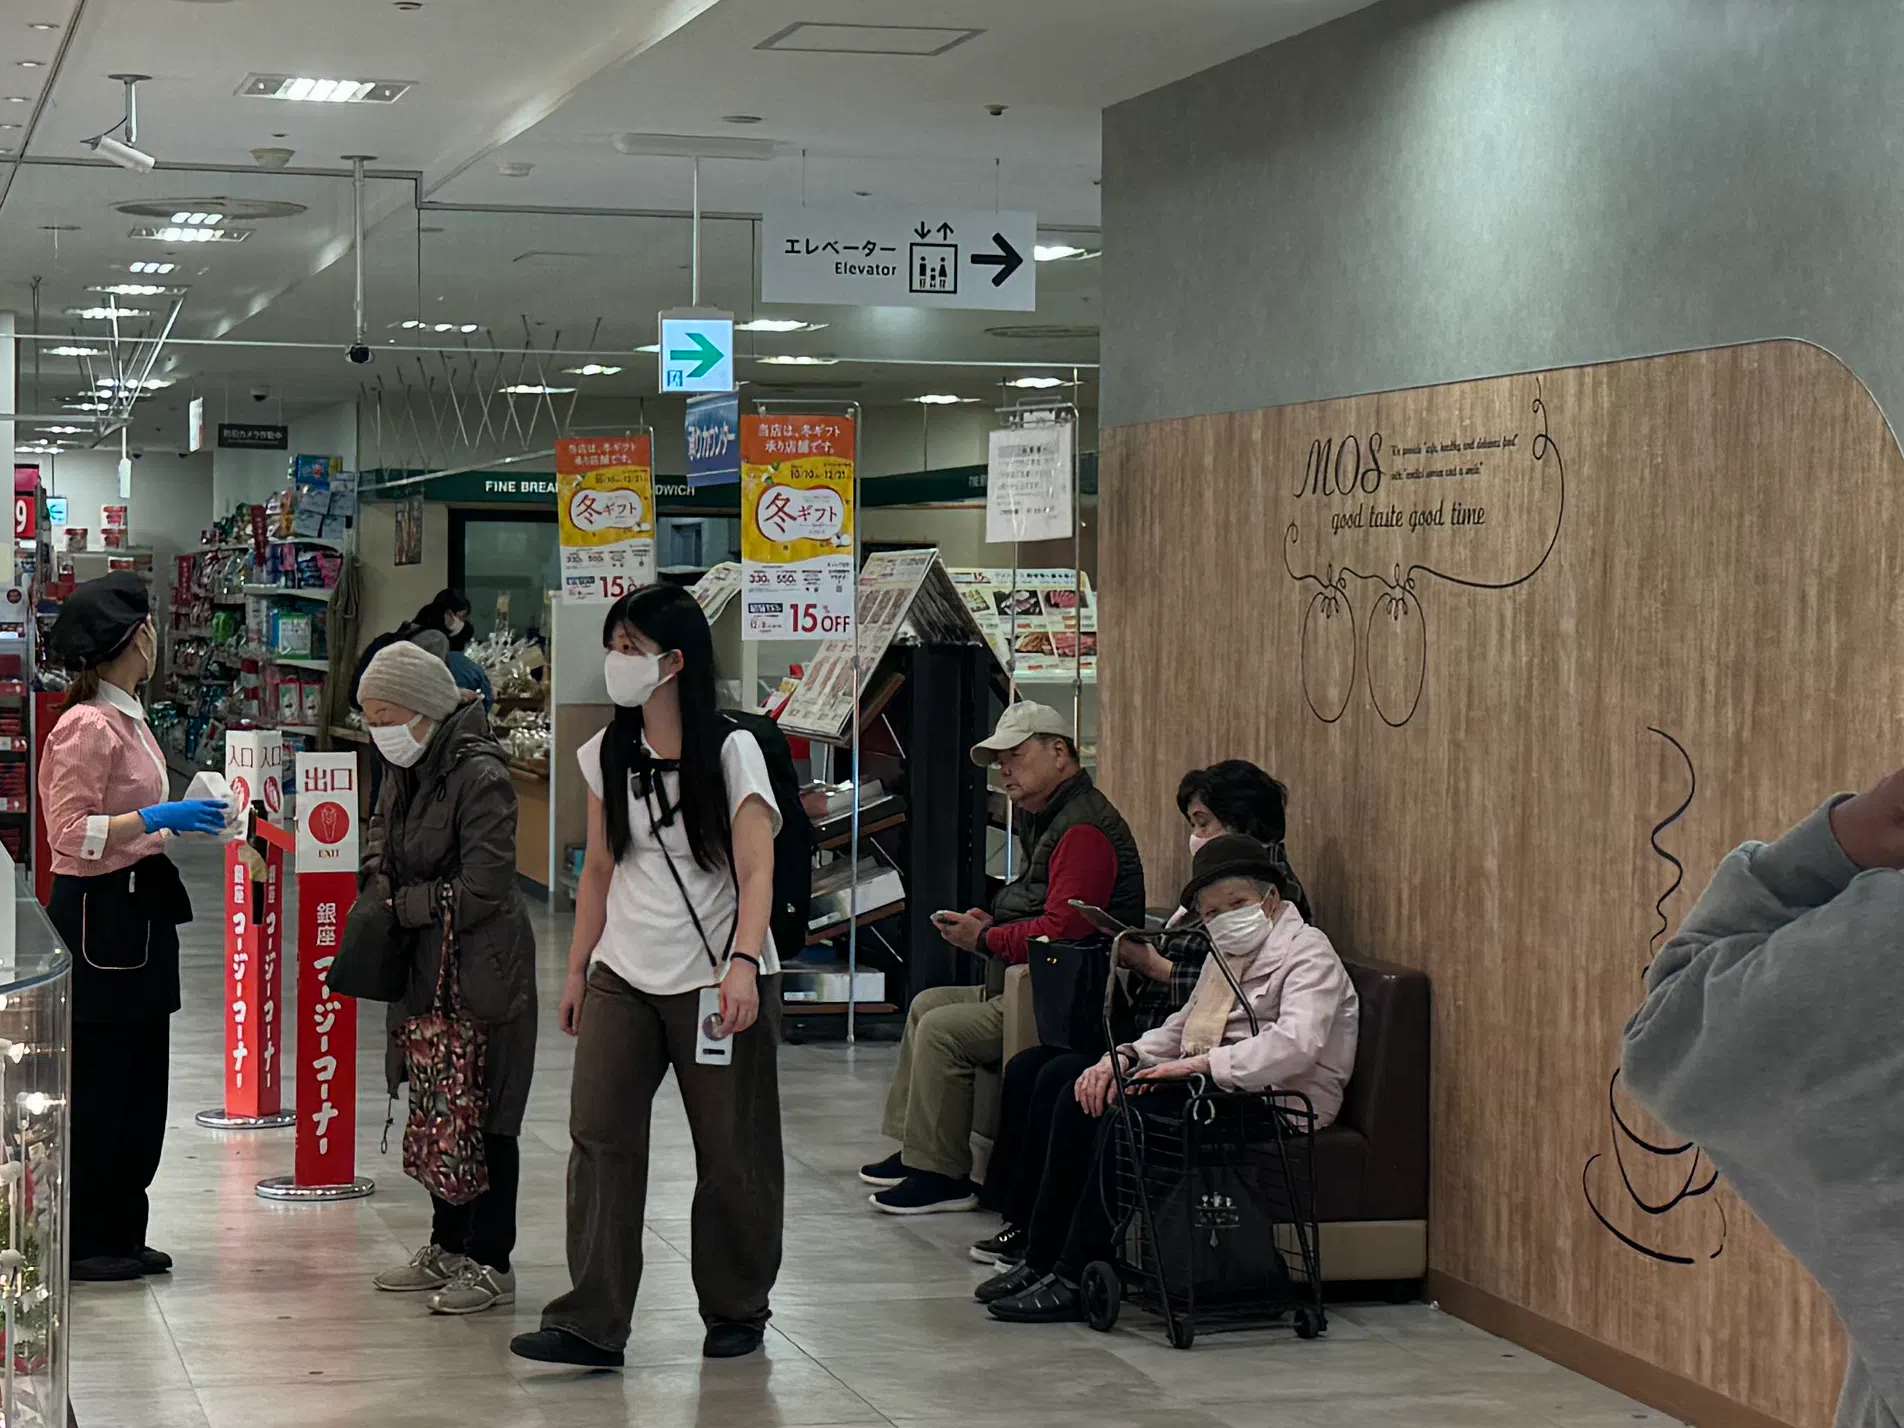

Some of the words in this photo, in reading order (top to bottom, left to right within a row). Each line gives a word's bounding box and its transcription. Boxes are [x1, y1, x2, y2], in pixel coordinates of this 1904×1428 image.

[785, 238, 897, 258] エレベーター
[834, 261, 897, 276] Elevator
[1293, 432, 1386, 499] MOS
[485, 480, 518, 493] FINE
[576, 494, 638, 525] 冬ギフト
[763, 491, 838, 534] 冬ギフト
[1332, 503, 1365, 535] good
[1369, 504, 1404, 529] taste
[1408, 499, 1445, 533] good
[1451, 500, 1486, 526] time
[600, 576, 625, 598] 15
[790, 603, 818, 633] 15
[821, 616, 851, 633] OFF
[228, 745, 254, 768] 入口
[260, 745, 281, 768] 入口
[304, 767, 353, 793] 出口
